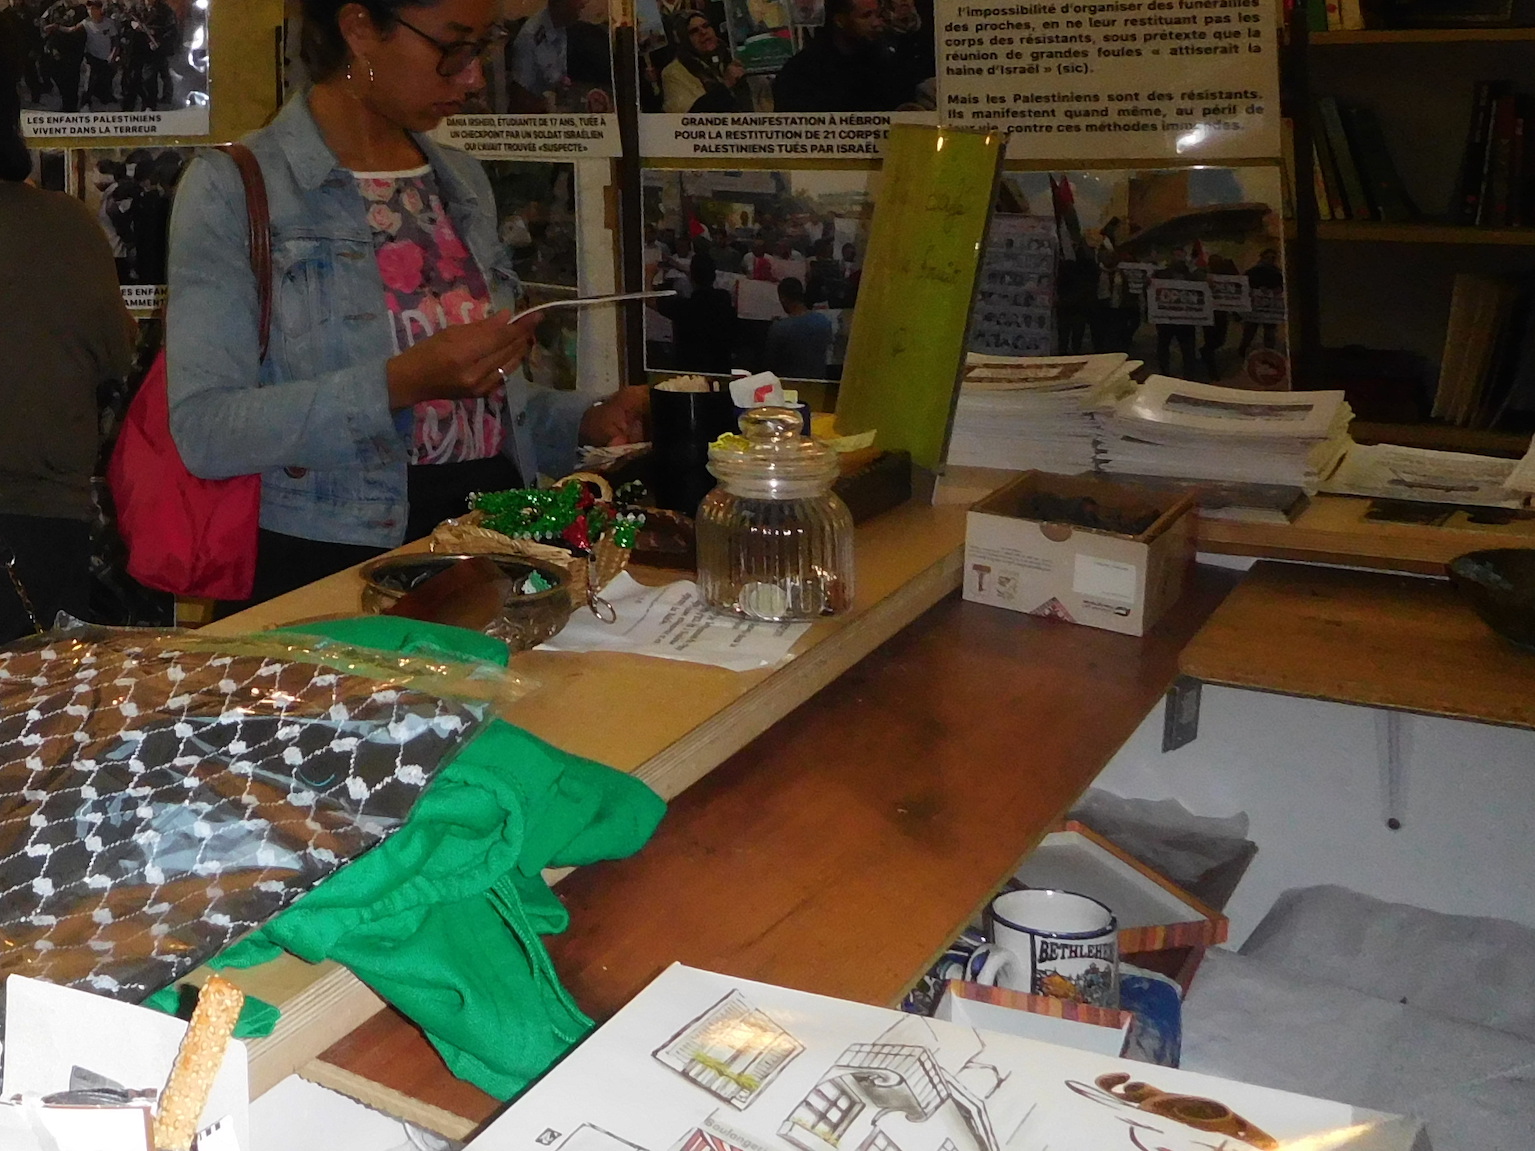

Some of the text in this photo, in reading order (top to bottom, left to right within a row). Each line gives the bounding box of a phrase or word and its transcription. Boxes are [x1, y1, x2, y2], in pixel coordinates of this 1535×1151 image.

[958, 3, 1056, 18] l'impossibilité
[1061, 0, 1143, 16] d'organiser
[1147, 0, 1174, 10] des
[944, 12, 1260, 33] des proches, en ne leur restituant pas les
[945, 27, 1261, 48] corps des résistants, sous prétexte que la
[946, 50, 998, 61] réunion
[1006, 50, 1022, 60] de
[1031, 47, 1089, 61] grandes
[1098, 47, 1142, 57] foules
[1169, 44, 1239, 55] attiserait
[1248, 43, 1262, 53] la
[946, 65, 983, 75] haine
[987, 63, 1039, 75] d'Israël
[1057, 63, 1094, 75] (sic).
[947, 89, 1263, 104] Mais les Palestiniens sont des résistants.
[948, 104, 1264, 119] Ils manifestent quand même, au péril de
[47, 116, 90, 124] ENFANTS
[94, 114, 161, 123] PALESTINIENS
[538, 118, 549, 126] DE
[559, 118, 578, 127] ANS,
[681, 114, 891, 126] GRANDE MANIFESTATION À HÉBRON
[32, 125, 157, 135] VIVENT DANS LA TERREUR
[1007, 123, 1052, 133] contre
[1057, 123, 1081, 132] ces
[1085, 120, 1158, 132] méthodes
[461, 130, 504, 139] CHECKPOINT
[505, 130, 520, 139] PAR
[522, 130, 532, 139] UN
[533, 130, 562, 139] SOLDAT
[674, 130, 706, 140] POUR
[708, 130, 722, 140] LA
[726, 130, 803, 140] RESTITUTION
[806, 130, 821, 139] DE
[823, 130, 836, 139] 21
[838, 130, 882, 139] CORPS
[693, 143, 774, 153] PALESTINIENS
[778, 142, 807, 153] TUÉS
[810, 144, 833, 153] PAR
